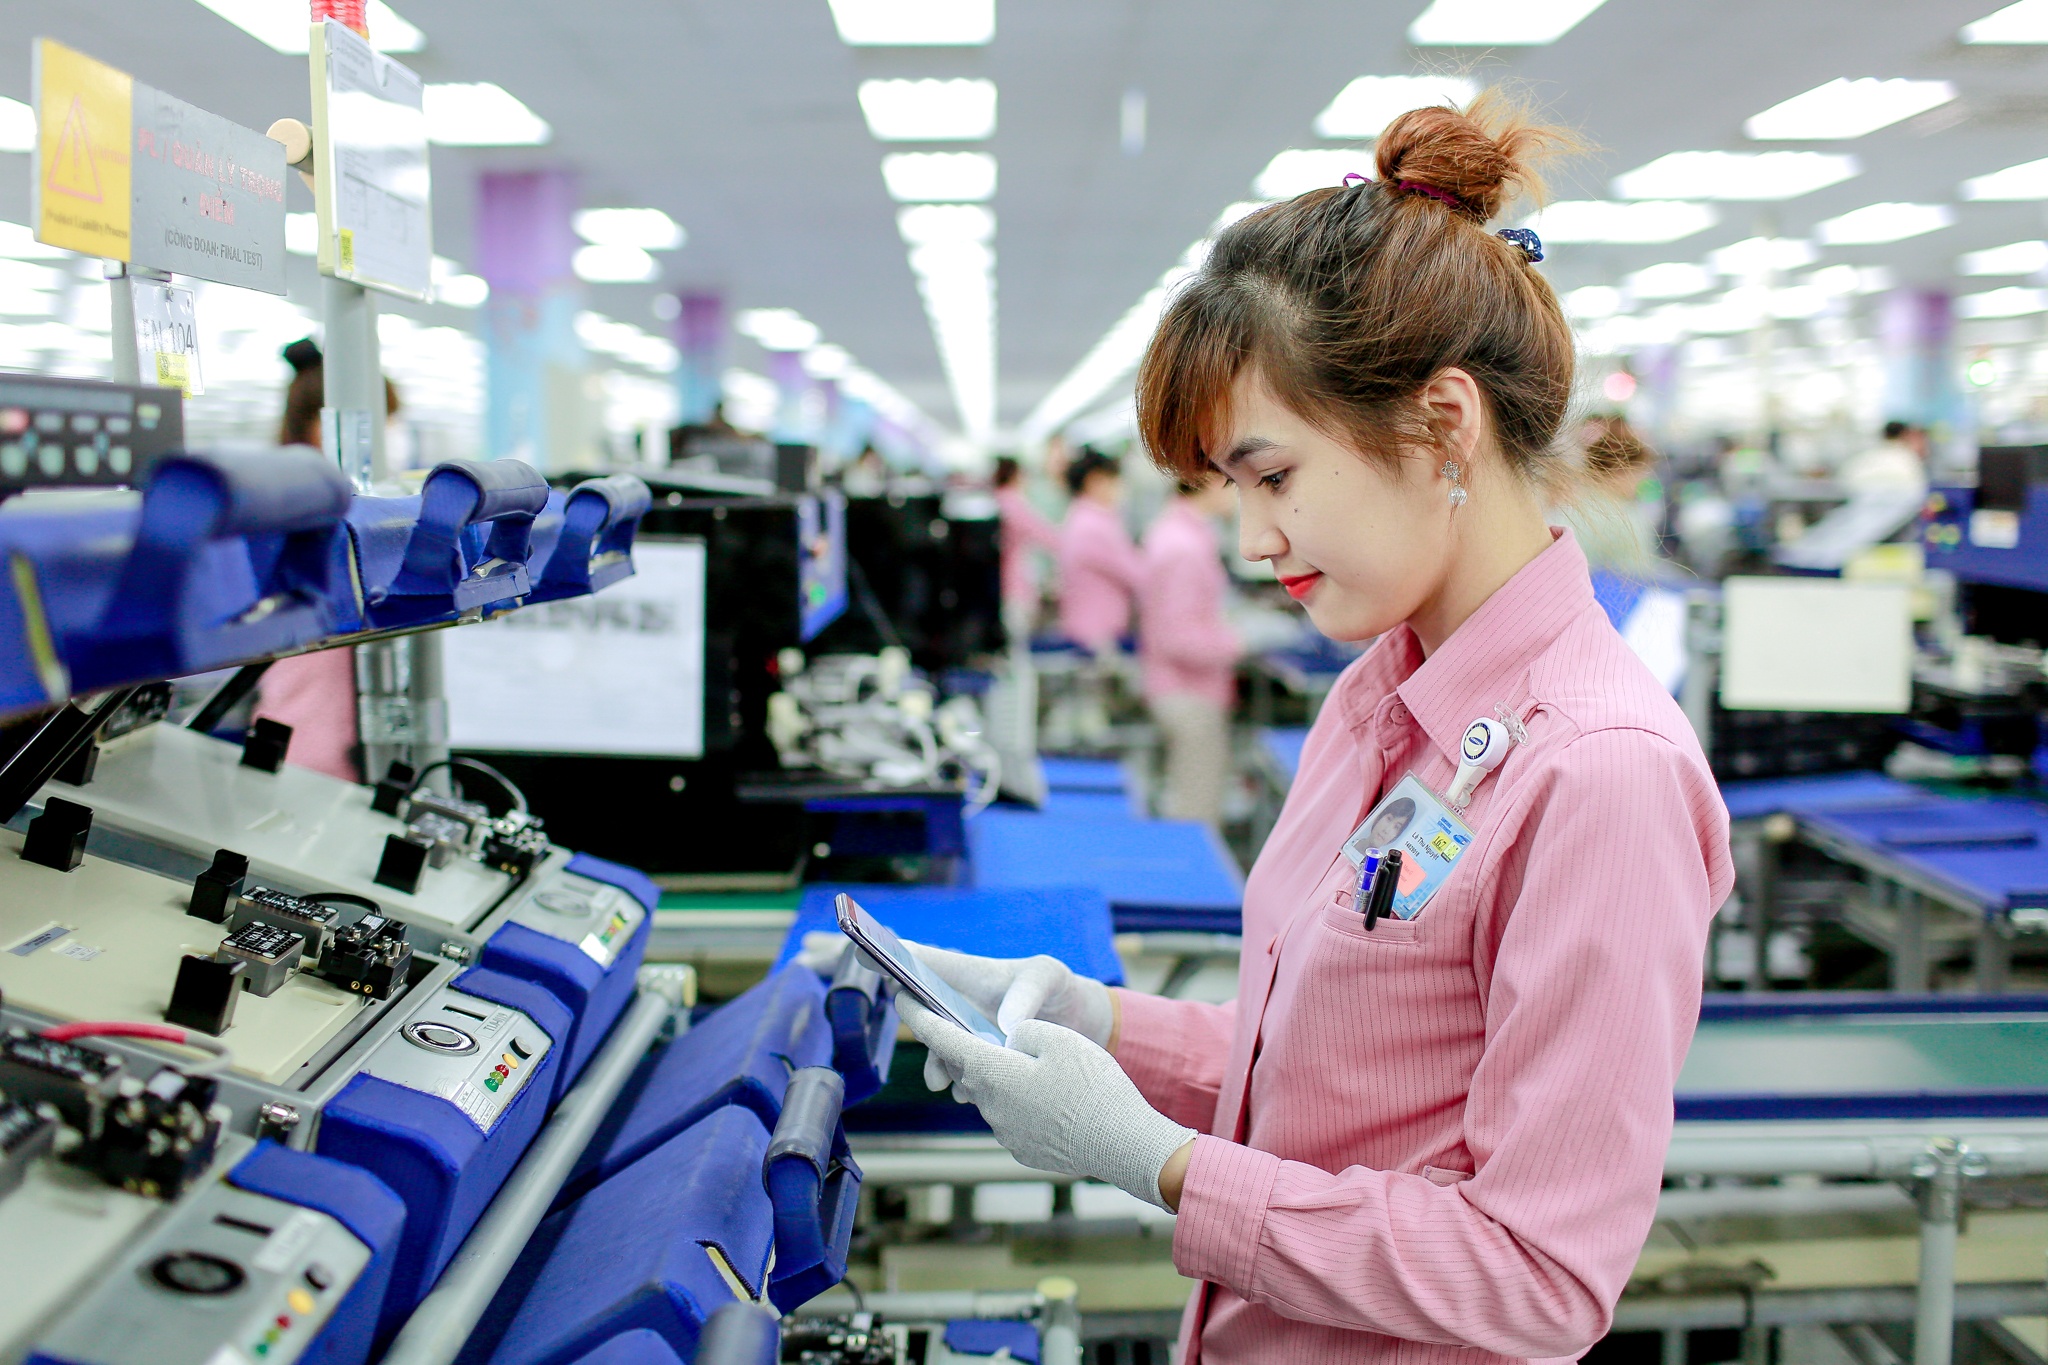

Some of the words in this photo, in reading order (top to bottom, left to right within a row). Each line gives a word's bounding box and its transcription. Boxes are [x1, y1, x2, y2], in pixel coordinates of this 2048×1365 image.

[138, 127, 159, 158] PL
[171, 139, 214, 179] QUẢN
[219, 155, 236, 186] LÝ
[220, 244, 242, 262] FINAL
[242, 250, 263, 271] TEST)
